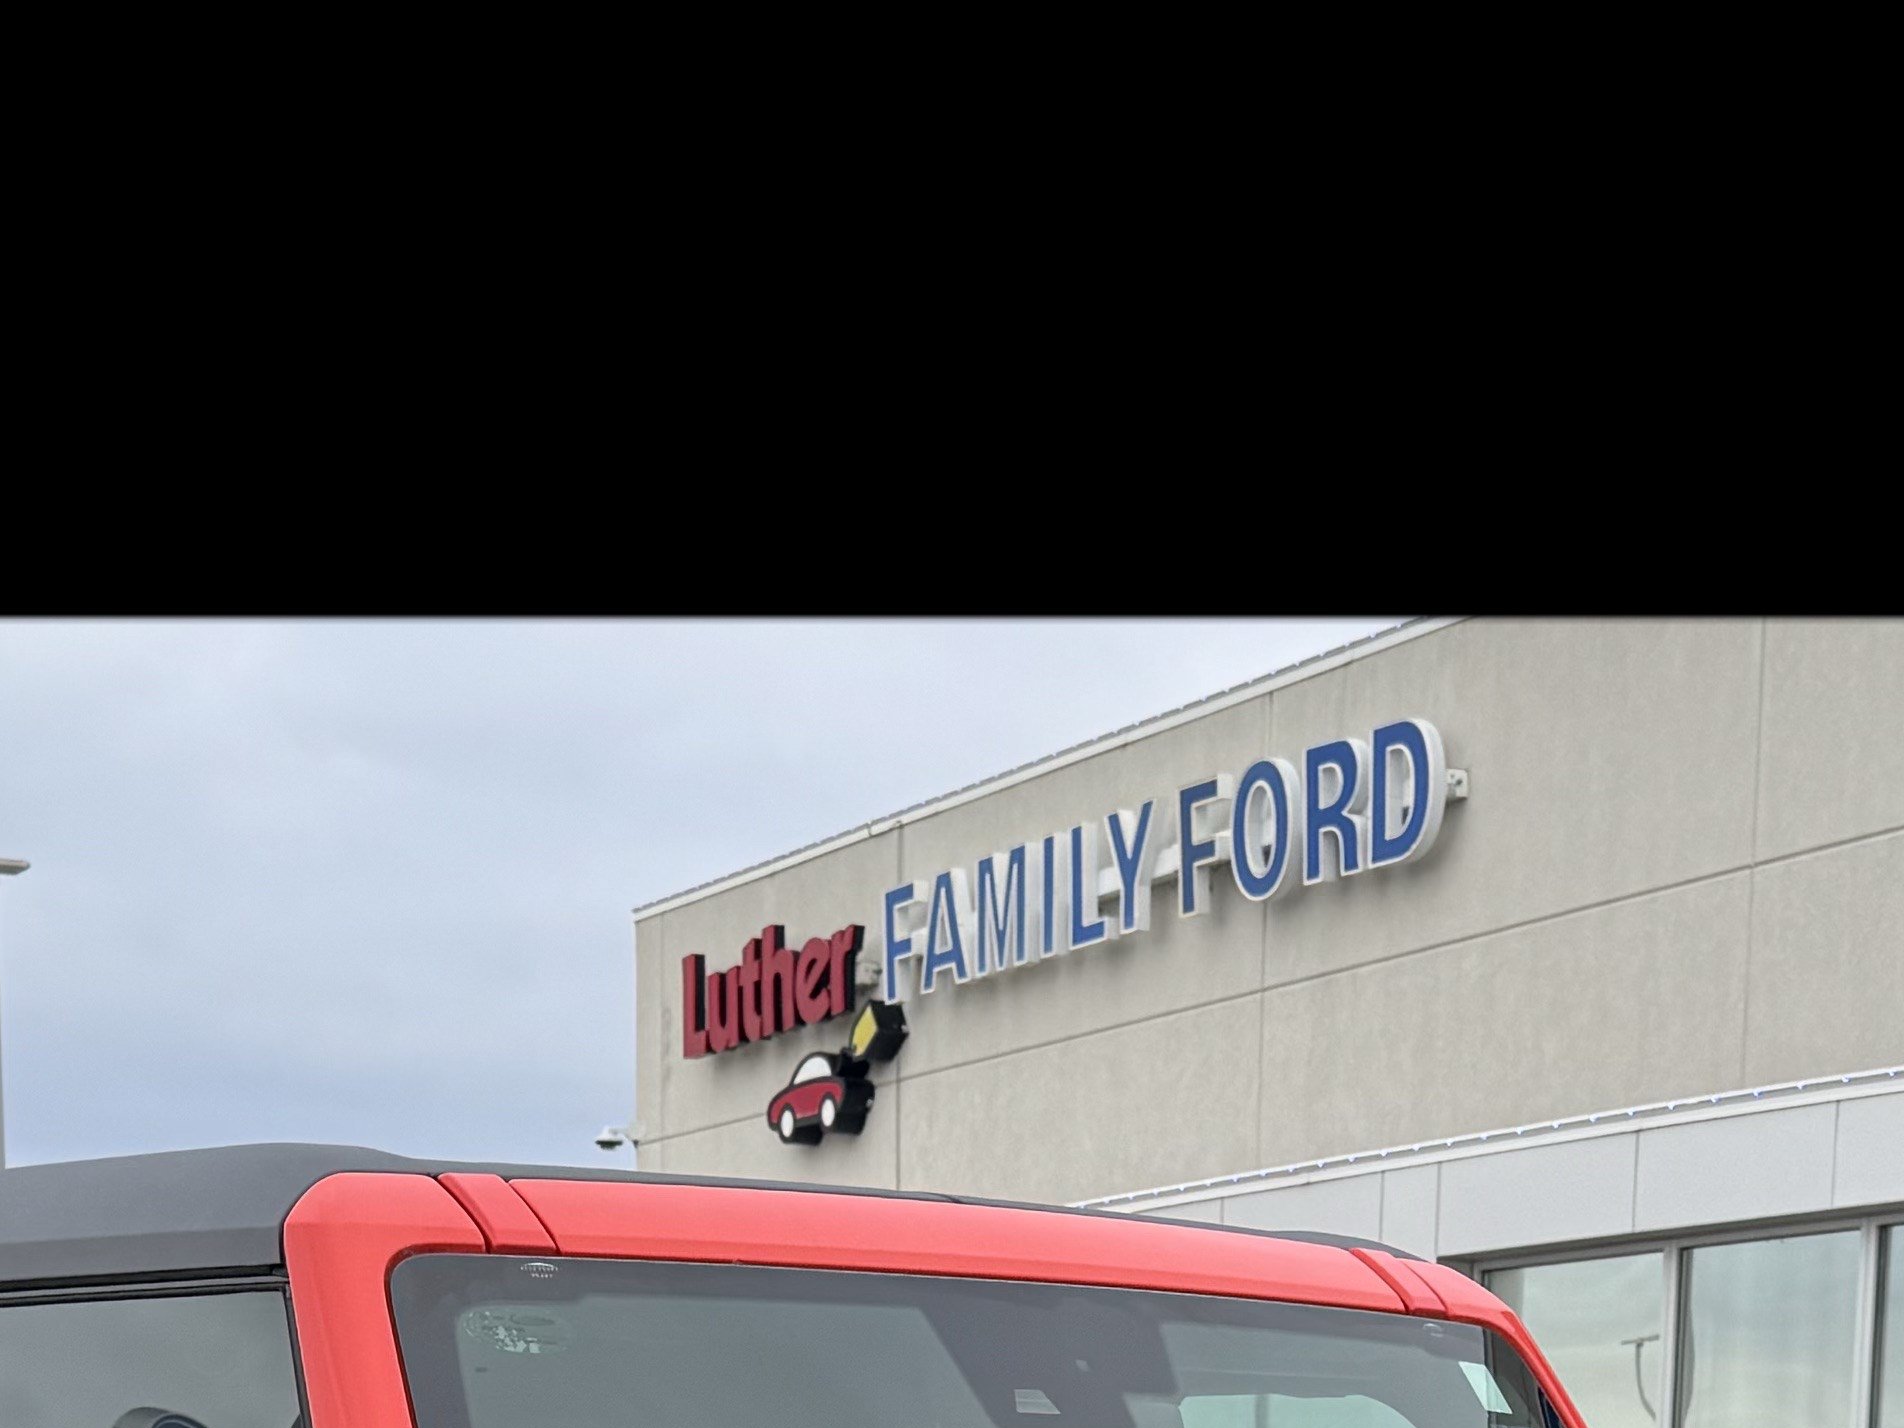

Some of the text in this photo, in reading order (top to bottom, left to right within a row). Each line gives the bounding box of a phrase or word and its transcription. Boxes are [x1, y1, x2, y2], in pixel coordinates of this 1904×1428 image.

[884, 718, 1443, 1004] FAMILY FORD
[682, 924, 864, 1059] Luther
